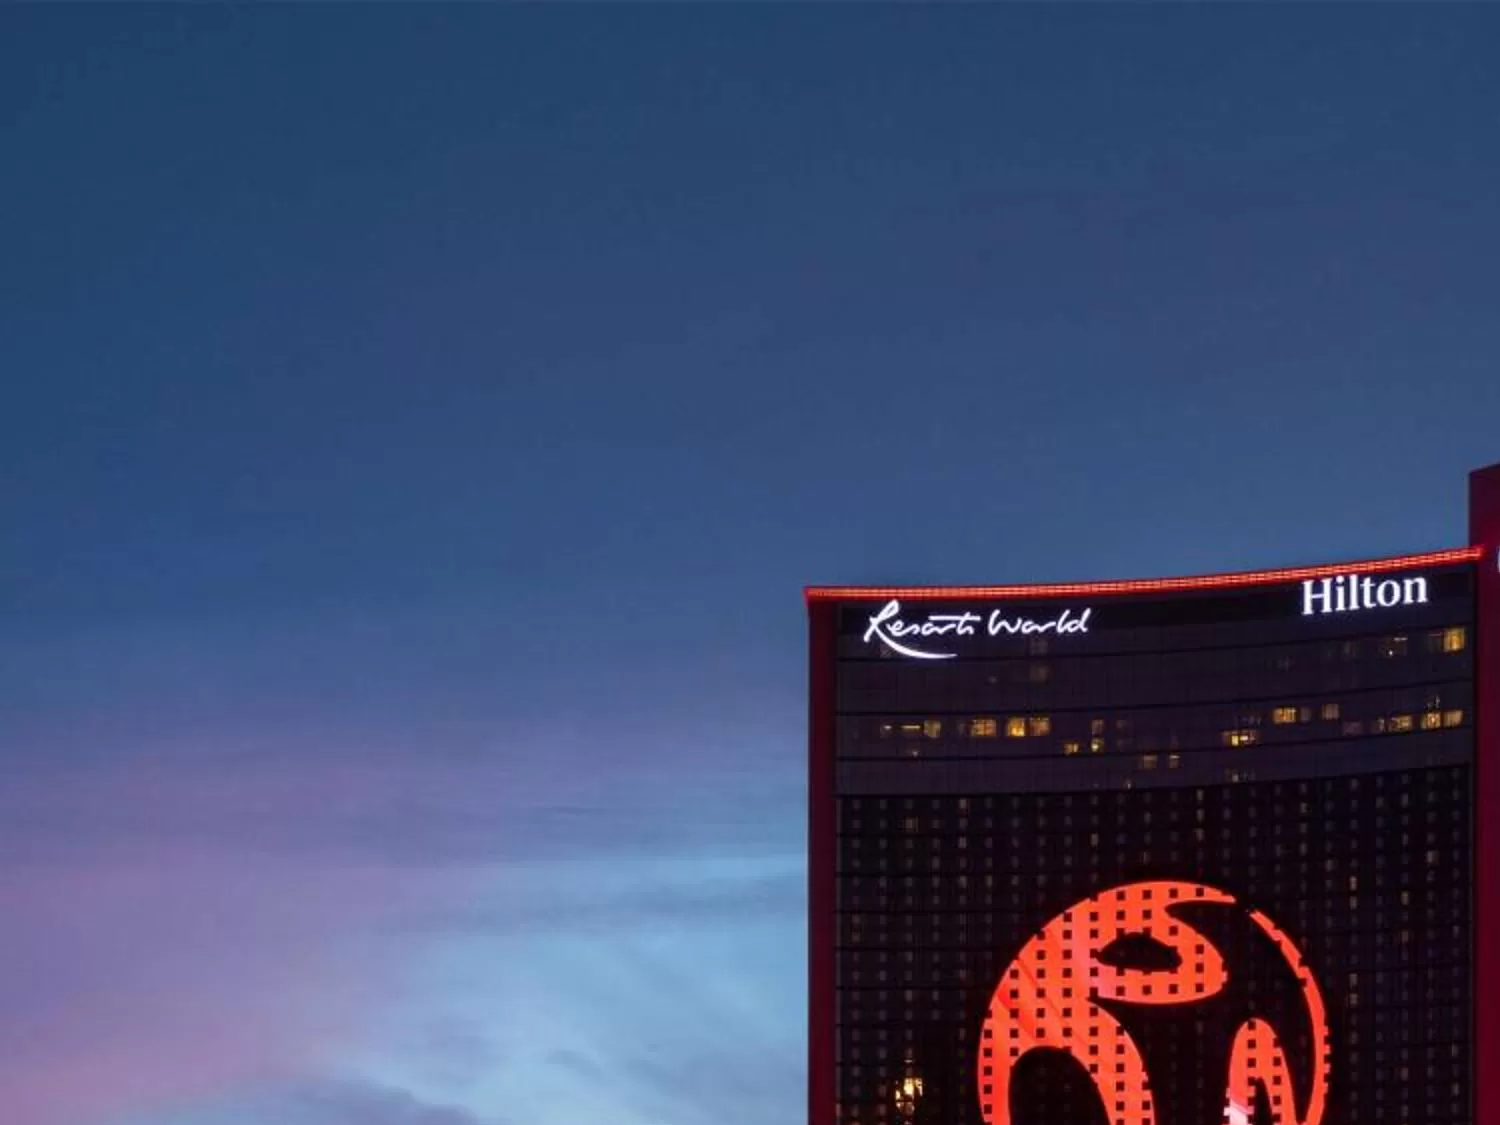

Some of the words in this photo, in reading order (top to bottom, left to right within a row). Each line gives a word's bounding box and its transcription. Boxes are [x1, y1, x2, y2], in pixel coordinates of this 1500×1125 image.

[1300, 575, 1429, 616] Hilton
[864, 599, 980, 659] Resorts
[987, 607, 1091, 636] World
